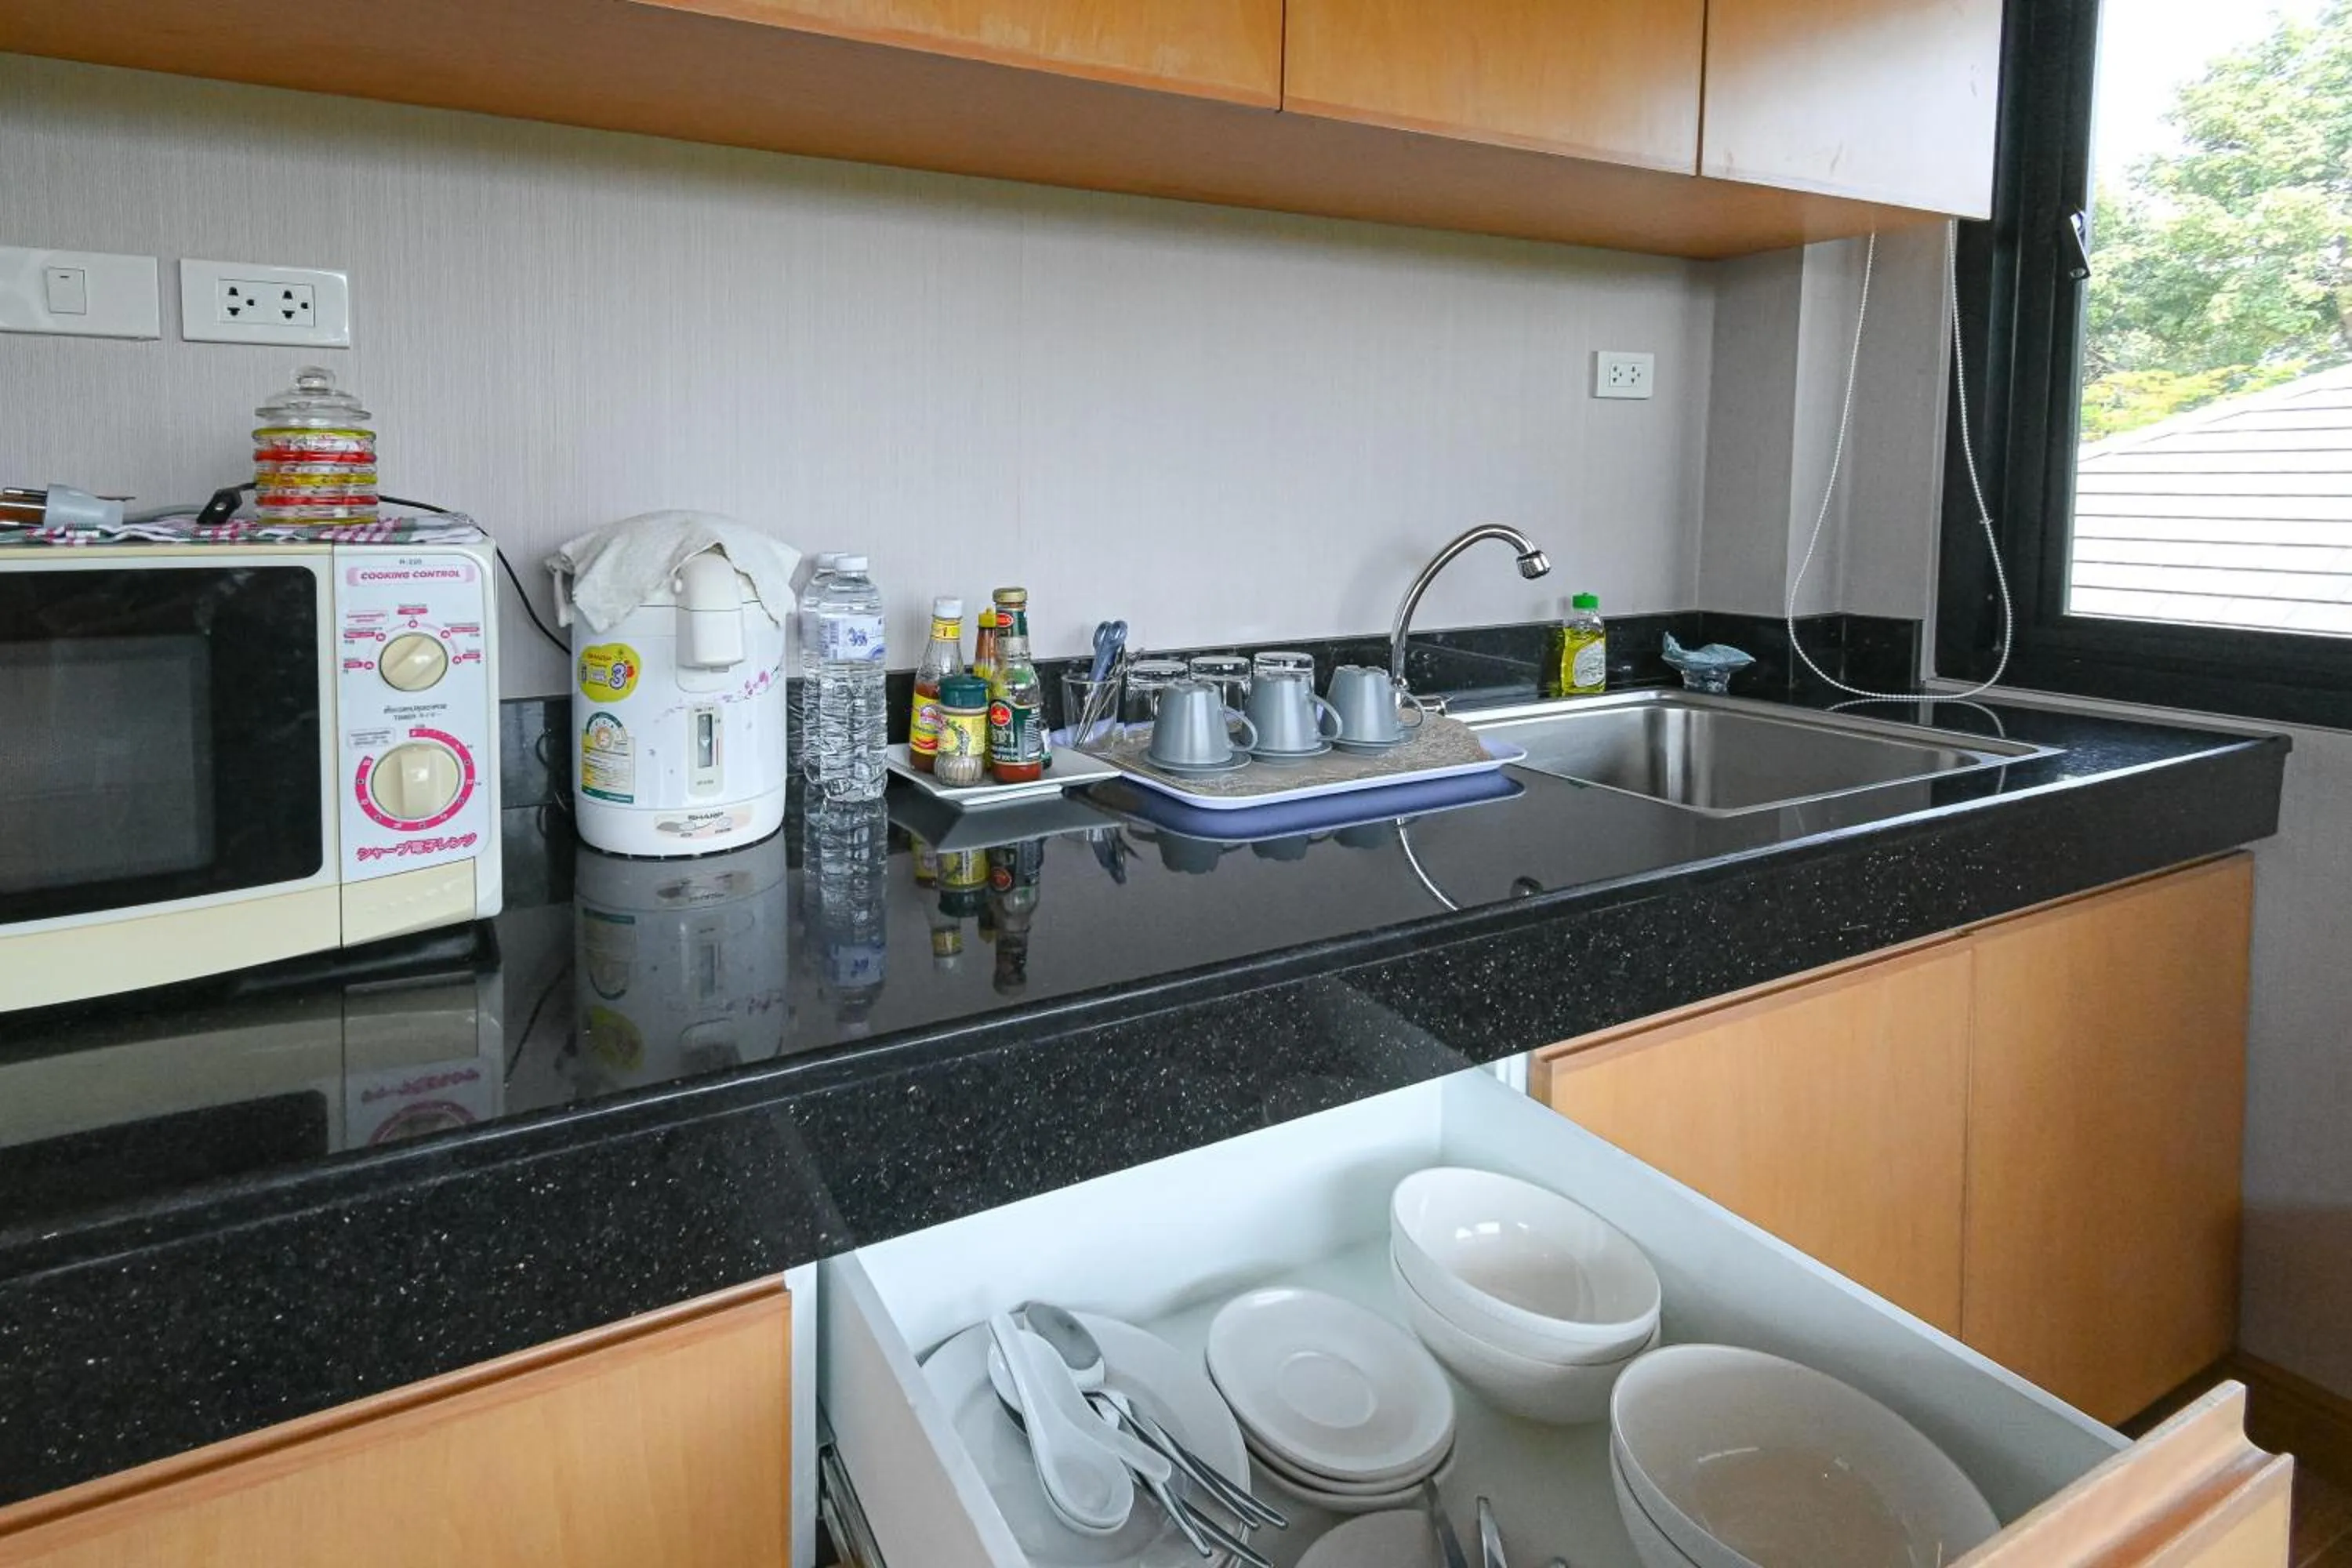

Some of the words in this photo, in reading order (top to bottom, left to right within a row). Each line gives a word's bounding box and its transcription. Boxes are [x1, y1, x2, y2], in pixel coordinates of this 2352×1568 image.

[360, 571, 410, 580] COOKING
[412, 569, 460, 579] CONTROL
[608, 662, 626, 690] 3
[688, 811, 724, 821] SHARP
[357, 832, 477, 862] シャープ電子レンジ
